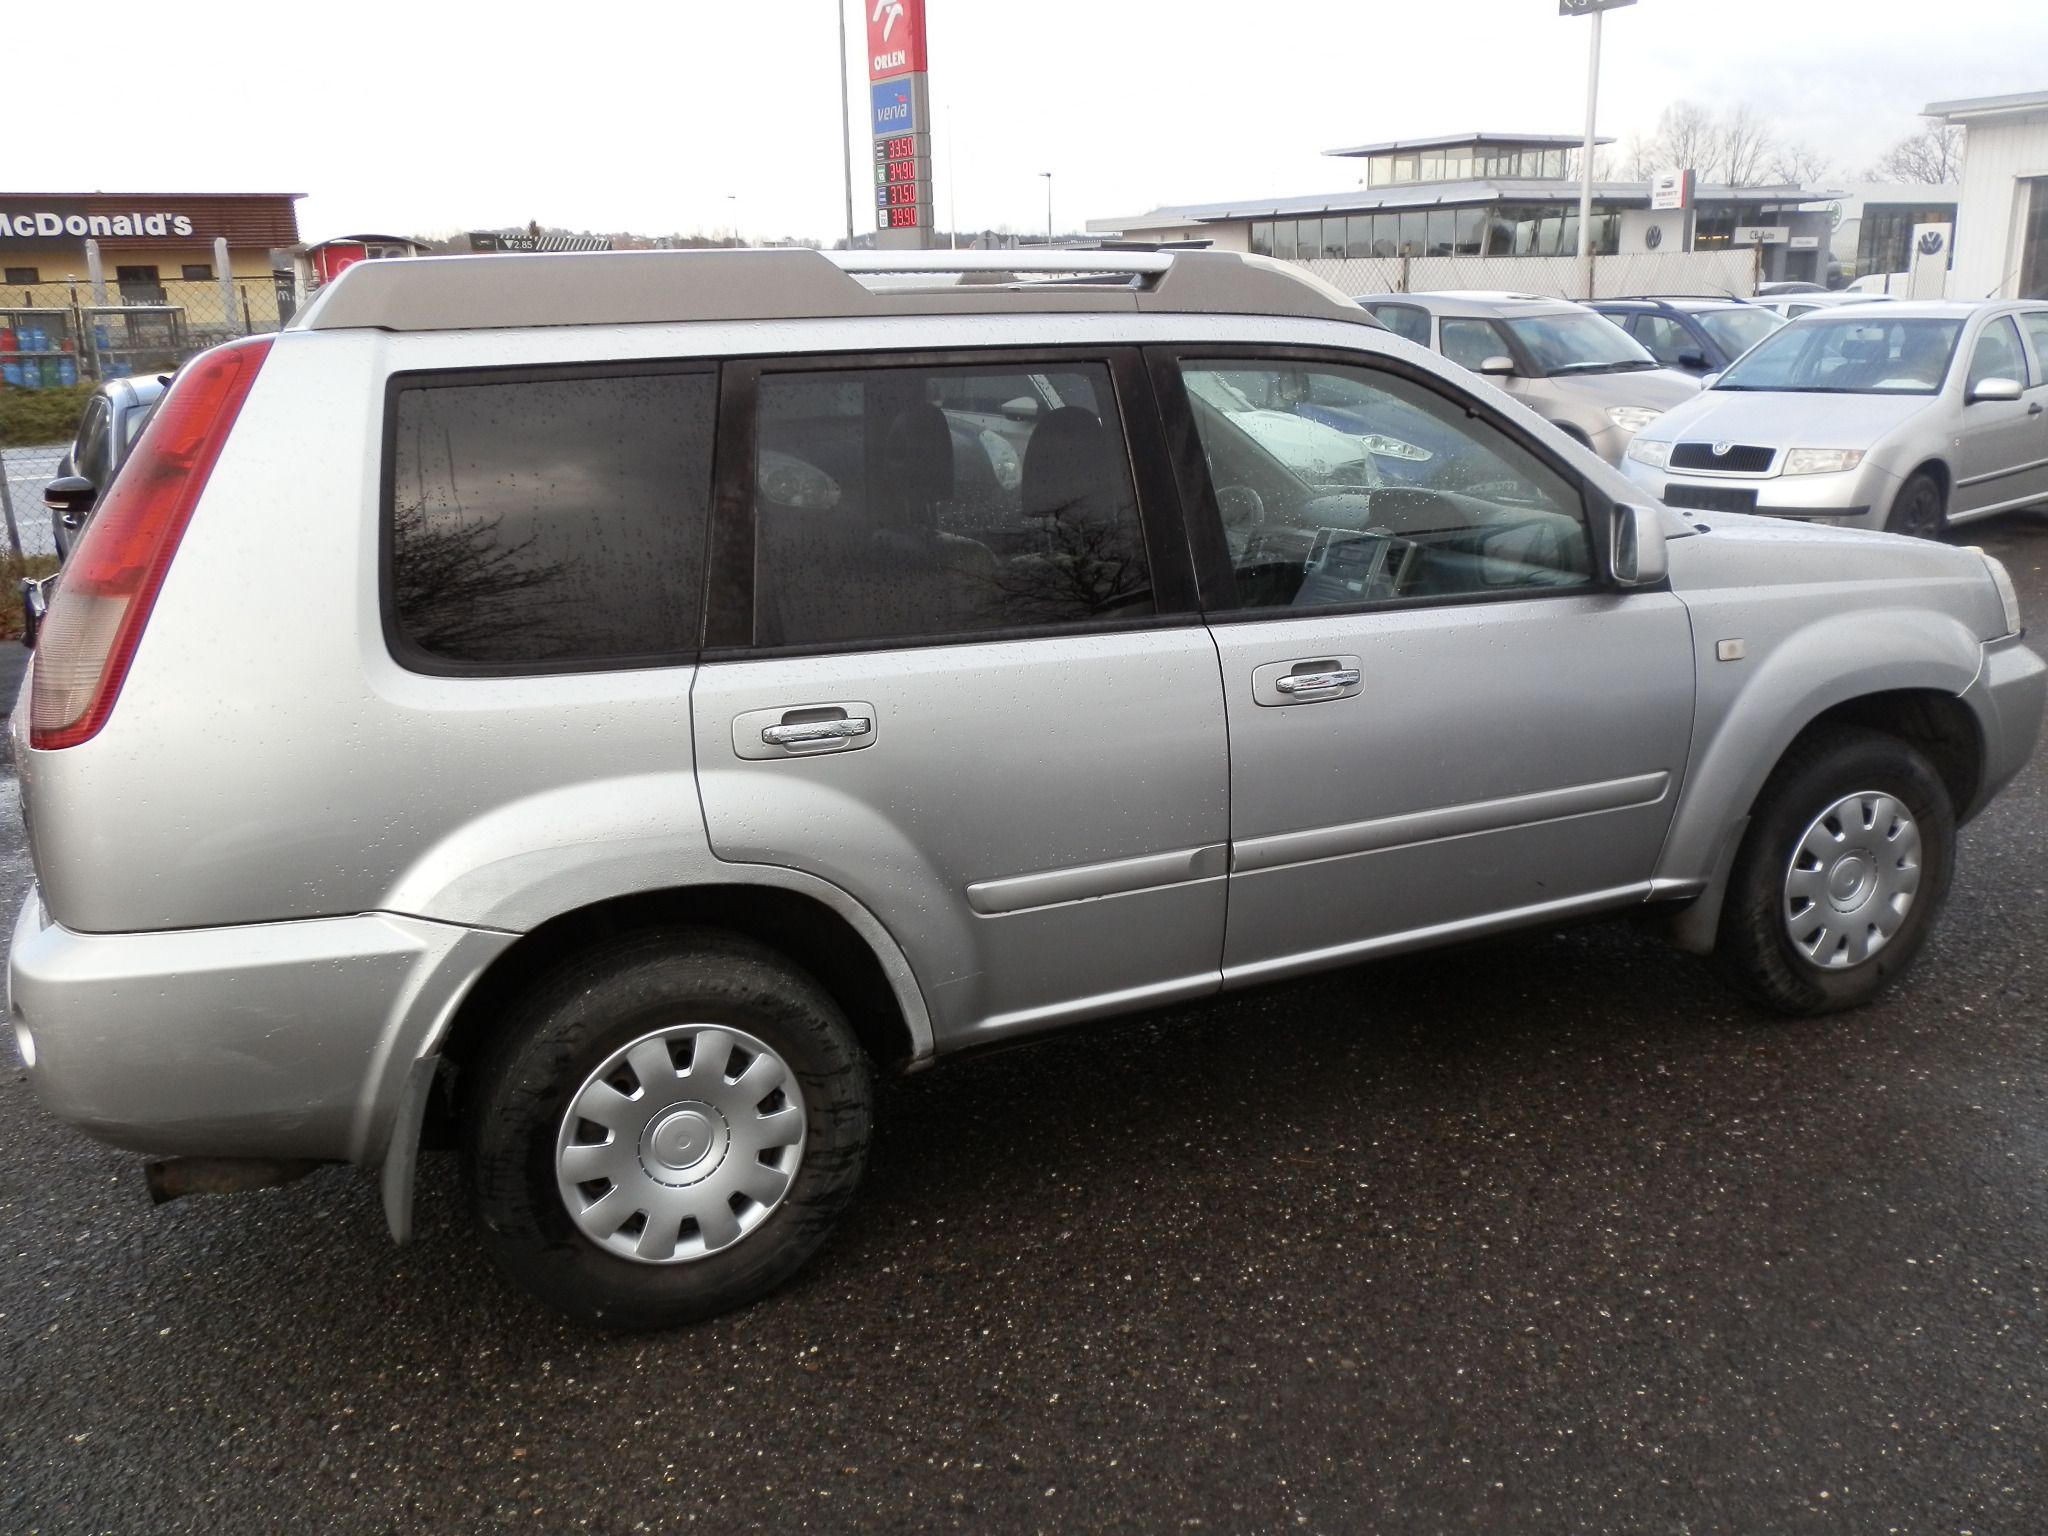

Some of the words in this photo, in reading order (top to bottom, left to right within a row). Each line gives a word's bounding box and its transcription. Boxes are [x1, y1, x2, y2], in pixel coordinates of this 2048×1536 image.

[874, 50, 906, 71] ORLEN
[877, 103, 907, 121] verva
[888, 137, 914, 158] 33.50
[889, 160, 915, 181] 34.90
